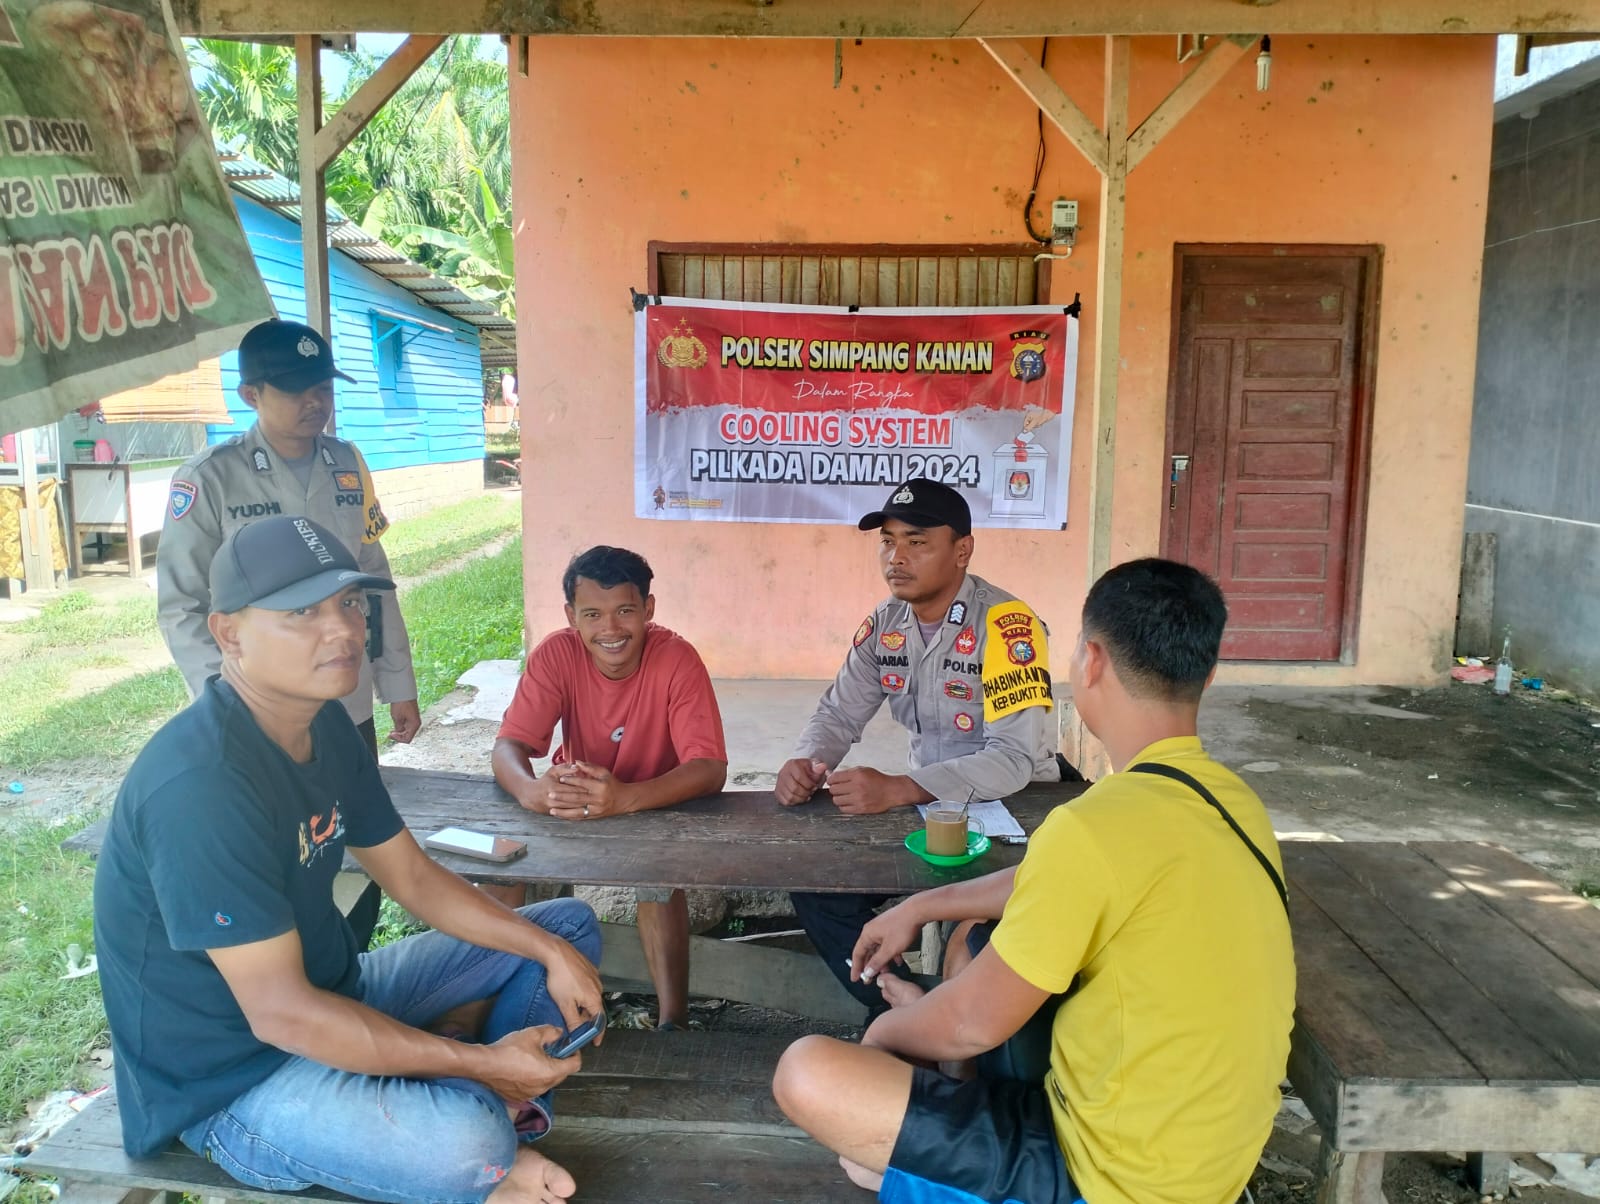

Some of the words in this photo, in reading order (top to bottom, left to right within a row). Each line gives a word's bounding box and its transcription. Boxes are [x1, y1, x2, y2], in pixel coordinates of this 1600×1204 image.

[1012, 331, 1048, 340] RIAU
[720, 336, 805, 368] POLSEK
[808, 340, 911, 372] SIMPANG
[914, 341, 994, 374] KANAN
[792, 378, 848, 401] Dalam
[848, 381, 915, 409] Rangka
[720, 412, 842, 447] COOLING
[848, 415, 954, 449] SYSTEM
[691, 449, 806, 485] PILKADA
[810, 452, 903, 486] DAMAI
[905, 454, 980, 489] 2024
[227, 501, 282, 520] YUDHI
[943, 658, 983, 675] POLRI
[1008, 685, 1038, 705] BUKIT
